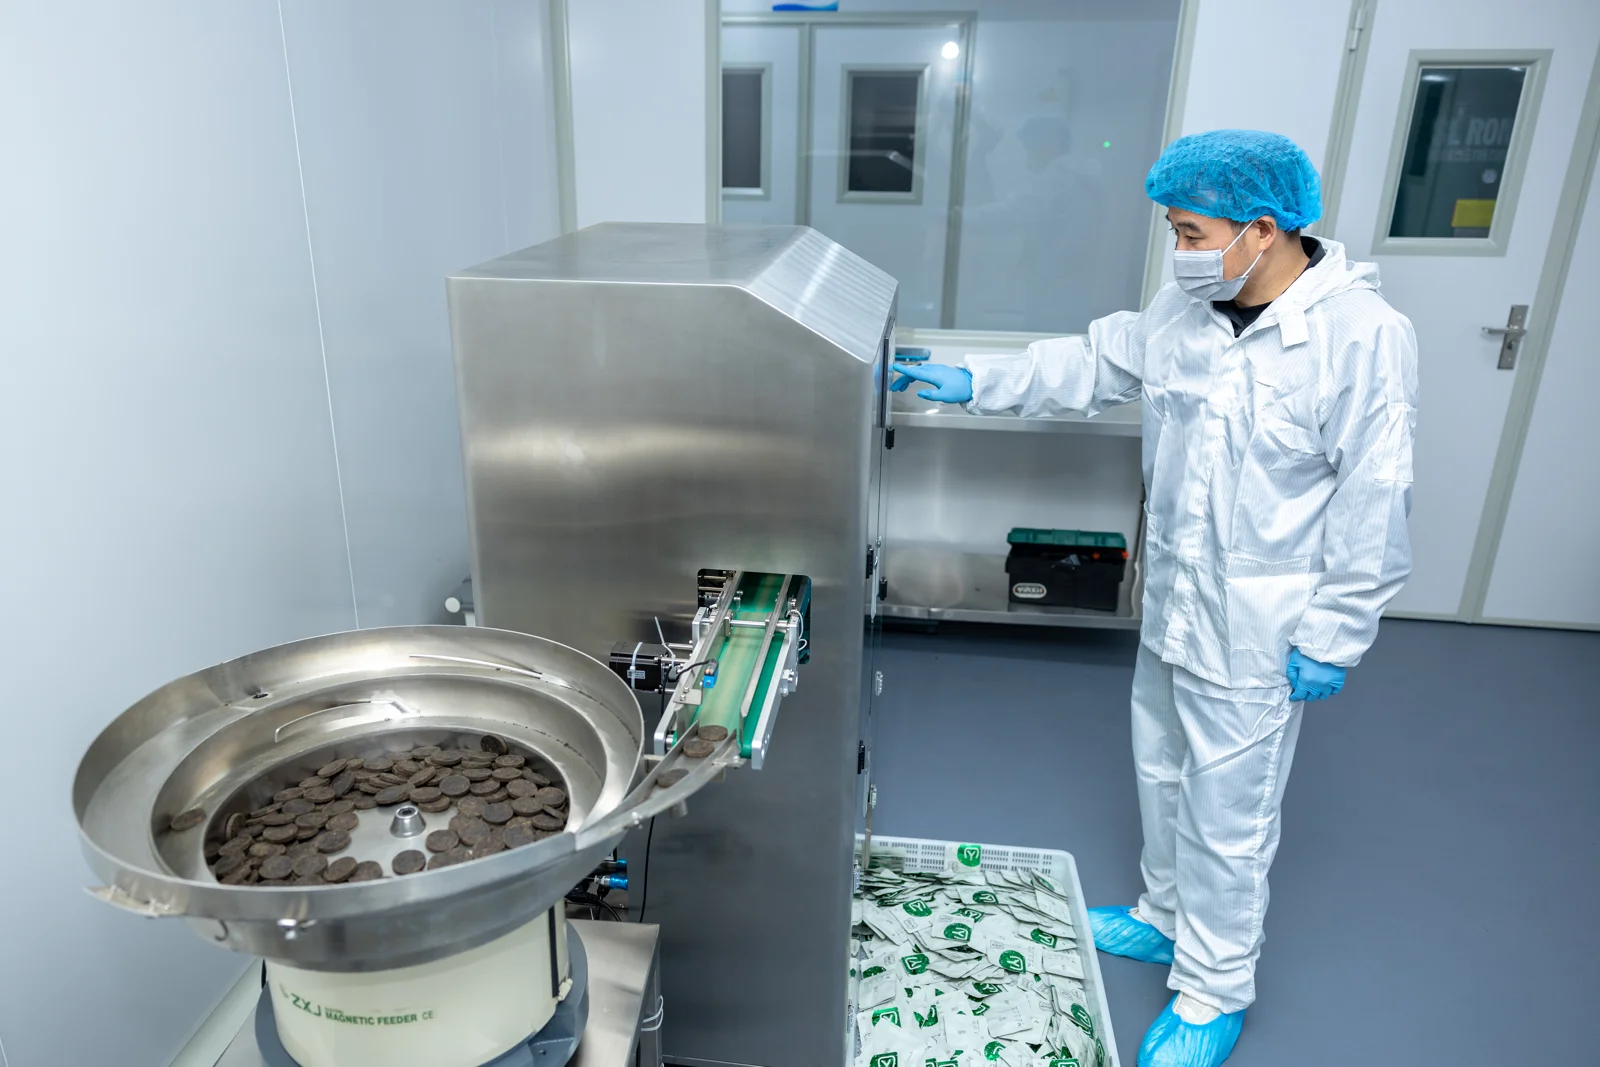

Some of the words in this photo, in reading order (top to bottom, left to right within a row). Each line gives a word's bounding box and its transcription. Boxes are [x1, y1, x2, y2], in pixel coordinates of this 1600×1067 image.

[290, 992, 322, 1017] ZXJ
[325, 1011, 375, 1026] MAGNETIC
[376, 1013, 418, 1026] FEEDER
[421, 1010, 434, 1021] CE
